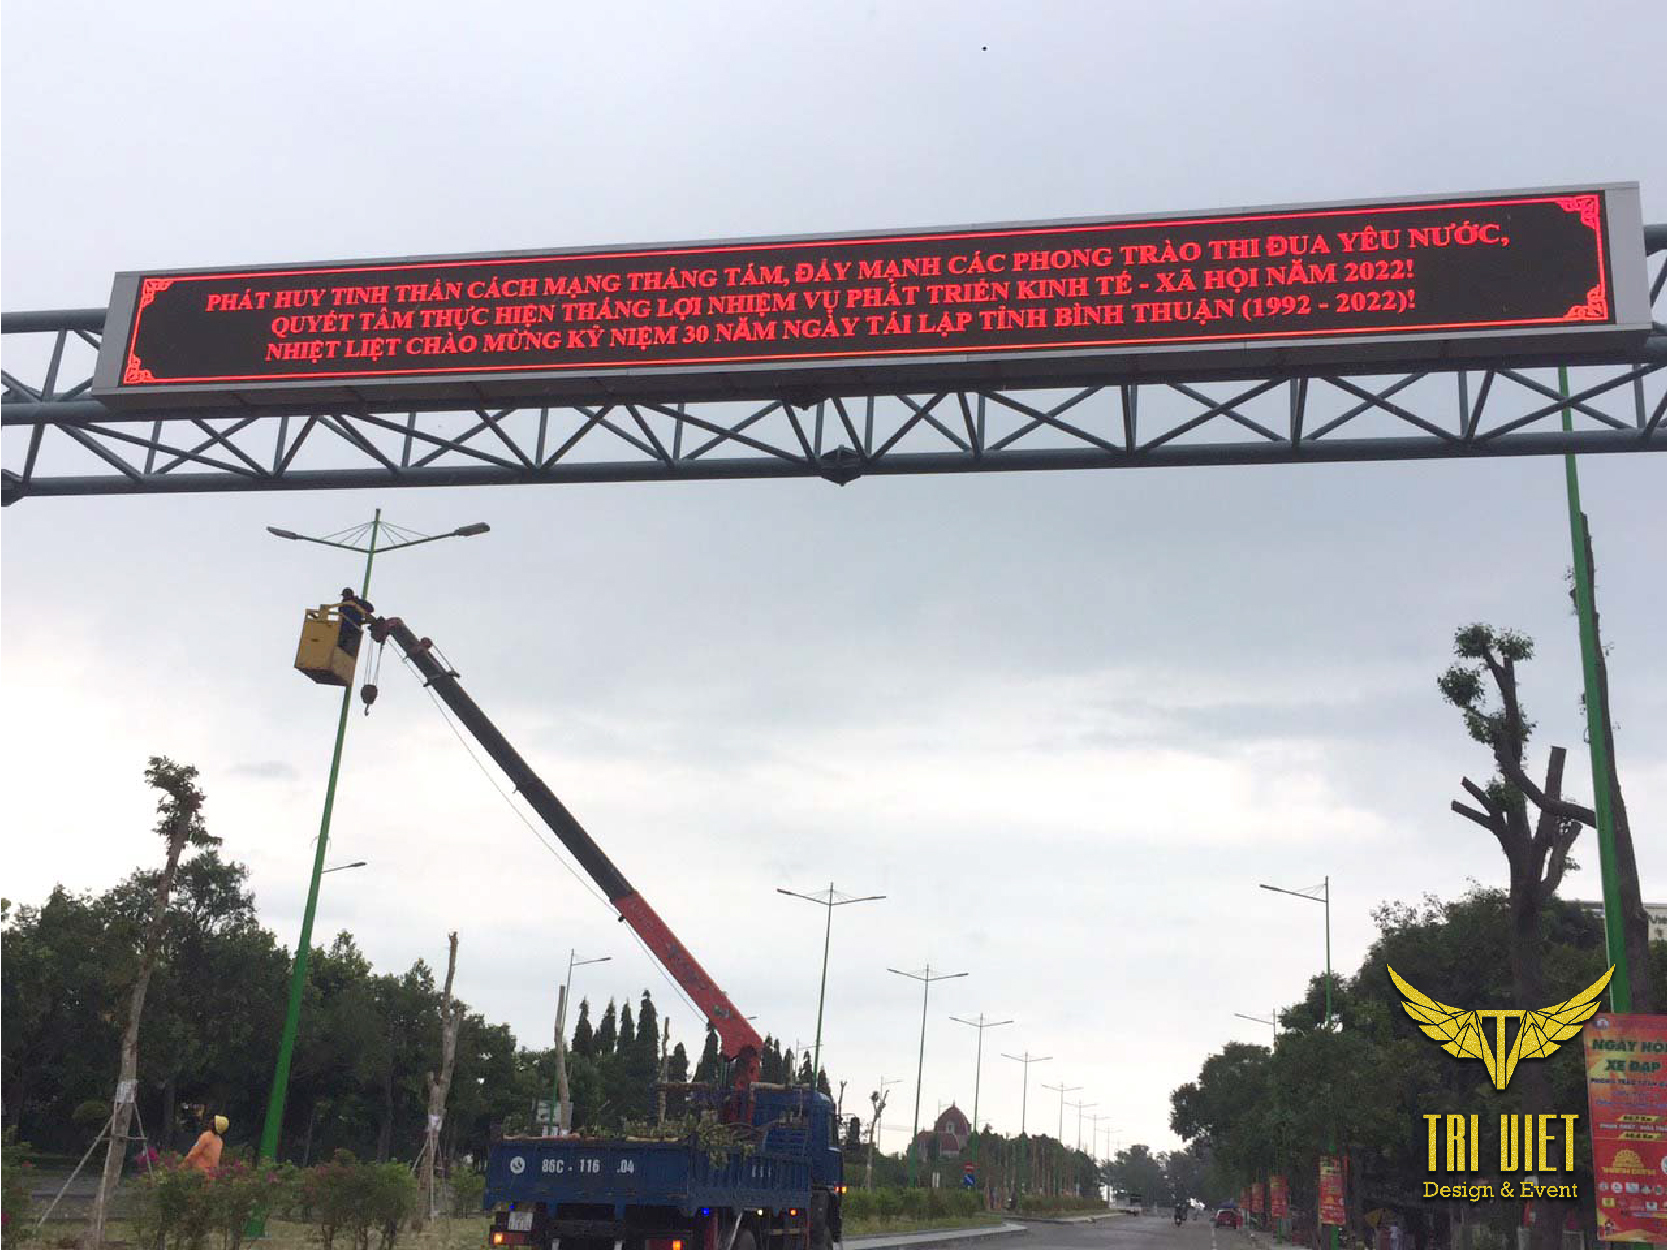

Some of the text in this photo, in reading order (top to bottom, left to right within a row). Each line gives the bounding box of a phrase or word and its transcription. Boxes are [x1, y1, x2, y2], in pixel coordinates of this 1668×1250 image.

[206, 289, 272, 312] PHÁT
[274, 289, 326, 310] HUY
[331, 284, 389, 307] TINH
[467, 276, 540, 299] CÁCH
[542, 273, 621, 299] MẠNG
[626, 268, 717, 292] THÁNG
[722, 263, 790, 286] TÁM,
[858, 255, 941, 282] MẠNH
[946, 250, 1006, 276] CÁC
[1014, 247, 1113, 271] PHONG
[1118, 240, 1201, 266] TRÀO
[1209, 237, 1261, 260] THI
[1264, 234, 1331, 261] ĐUA
[1337, 224, 1399, 253] YÊU
[1407, 219, 1509, 250] NƯỚC,
[360, 307, 415, 331] TÂM
[420, 305, 490, 332] THỰC
[493, 302, 555, 329] HIỆN
[657, 297, 704, 320] LỢI
[706, 292, 798, 318] NHIỆM
[803, 289, 839, 310] VỤ
[847, 282, 920, 310] PHÁT
[1016, 276, 1089, 302] KINH
[1154, 268, 1196, 294] XÃ
[1204, 266, 1259, 294] HỘI
[1266, 261, 1337, 289] NĂM
[1344, 258, 1415, 284] 2022!
[266, 339, 342, 365] NHIỆT
[344, 336, 402, 362] LIỆT
[407, 332, 480, 354] CHÀO
[610, 326, 678, 352] NIỆM
[683, 323, 709, 344] 30
[714, 317, 777, 344] NĂM
[782, 311, 860, 339] NGÀY
[865, 310, 912, 336] TÁI
[1055, 302, 1123, 328] BÌNH
[1240, 294, 1311, 320] (1992
[1337, 289, 1415, 312] 2022)!
